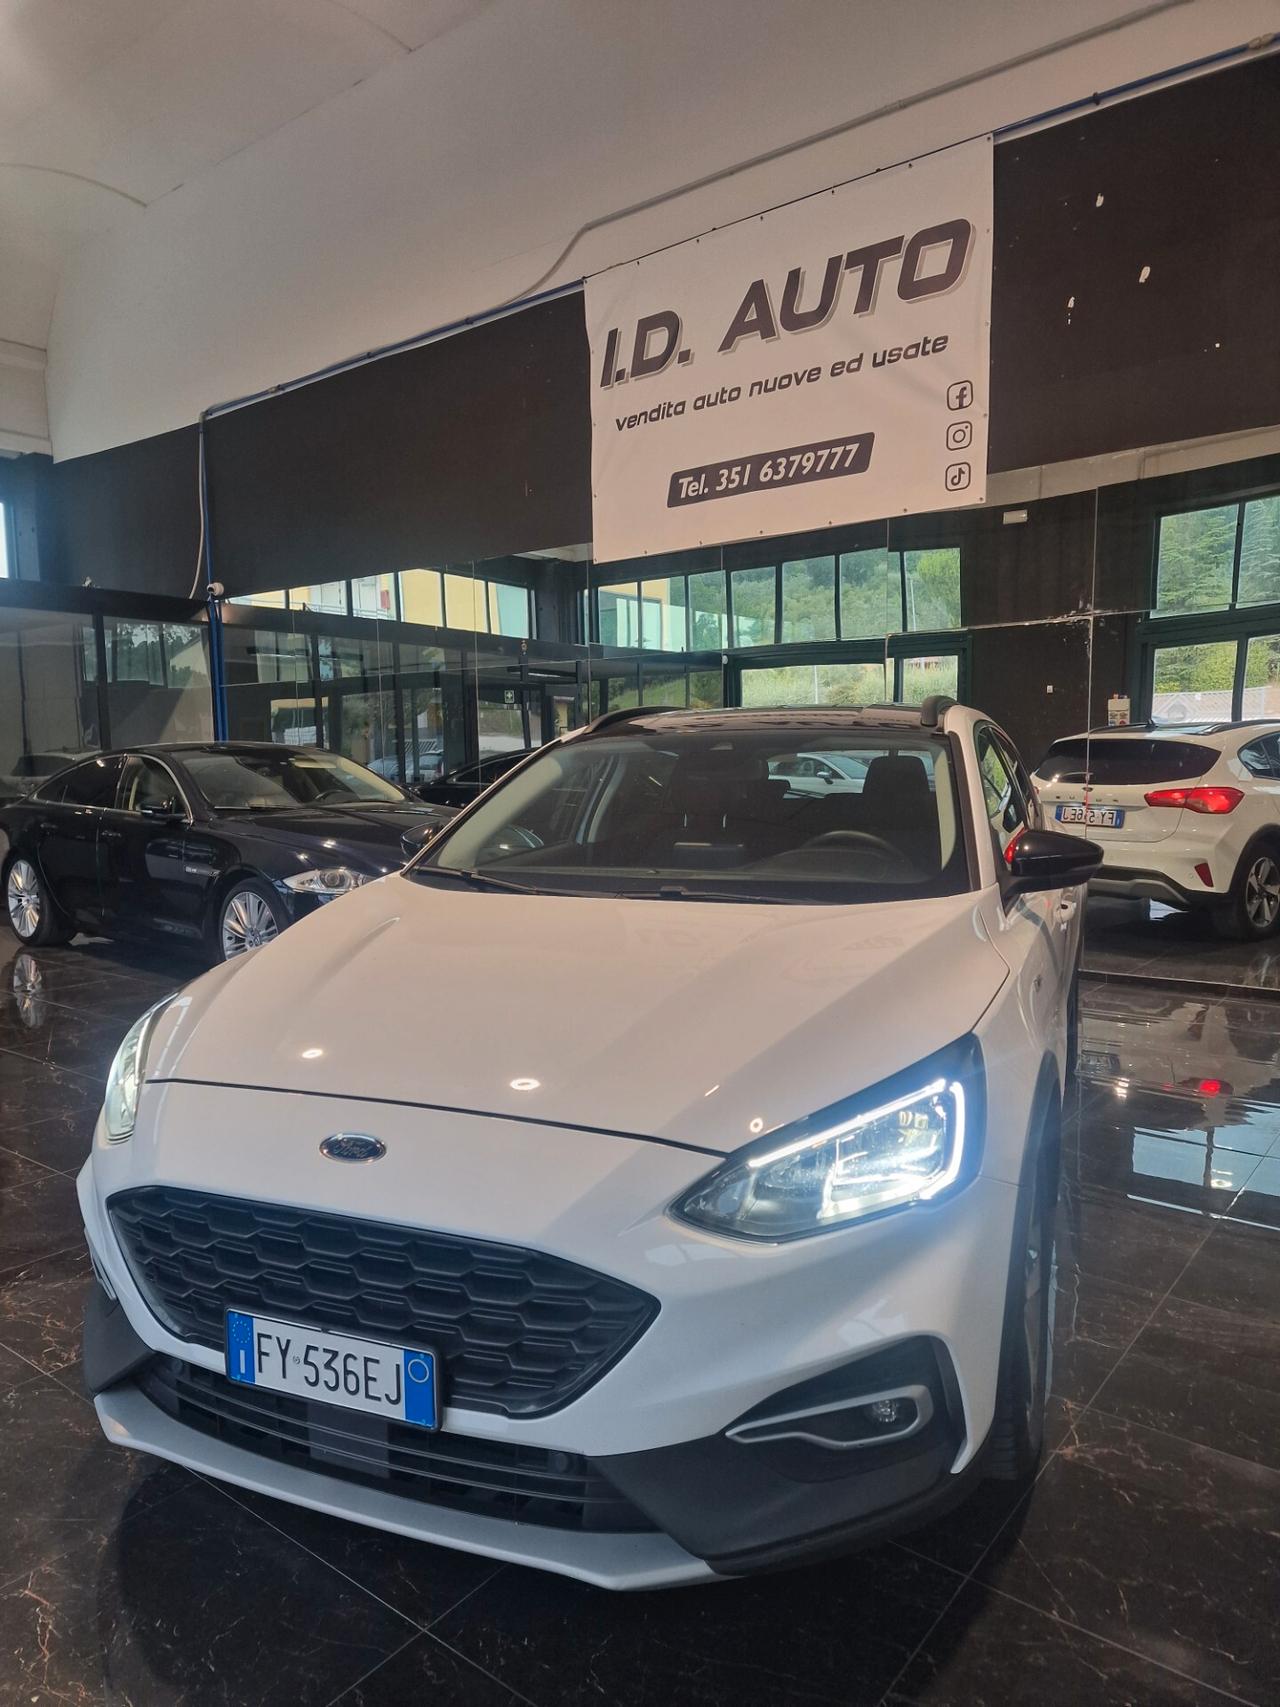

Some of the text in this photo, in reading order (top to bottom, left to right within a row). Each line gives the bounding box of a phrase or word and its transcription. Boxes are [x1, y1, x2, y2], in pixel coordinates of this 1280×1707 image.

[600, 218, 975, 389] I.D. AUTO
[615, 334, 949, 432] vendita auto nuove ed usate
[678, 442, 860, 498] Tel. 351 6379777
